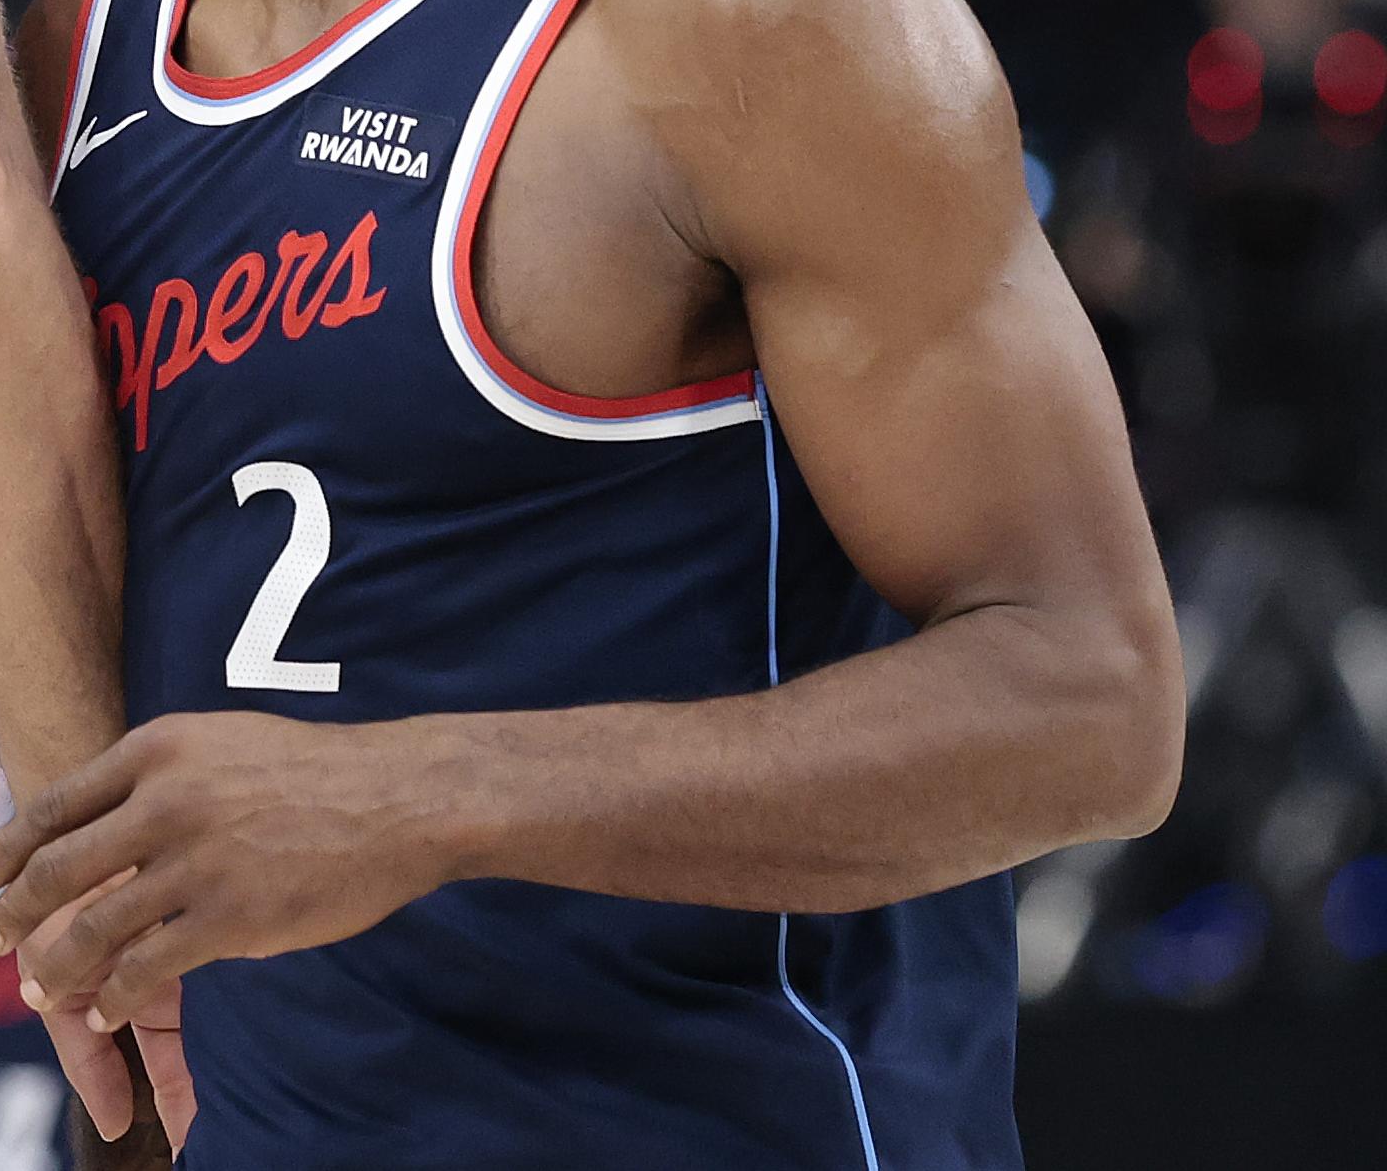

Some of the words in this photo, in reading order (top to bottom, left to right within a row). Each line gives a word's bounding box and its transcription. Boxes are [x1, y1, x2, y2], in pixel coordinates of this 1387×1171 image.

[300, 131, 429, 179] RWANDA
[341, 106, 418, 145] VISIT
[82, 210, 387, 452] ppers
[226, 461, 341, 692] 2
